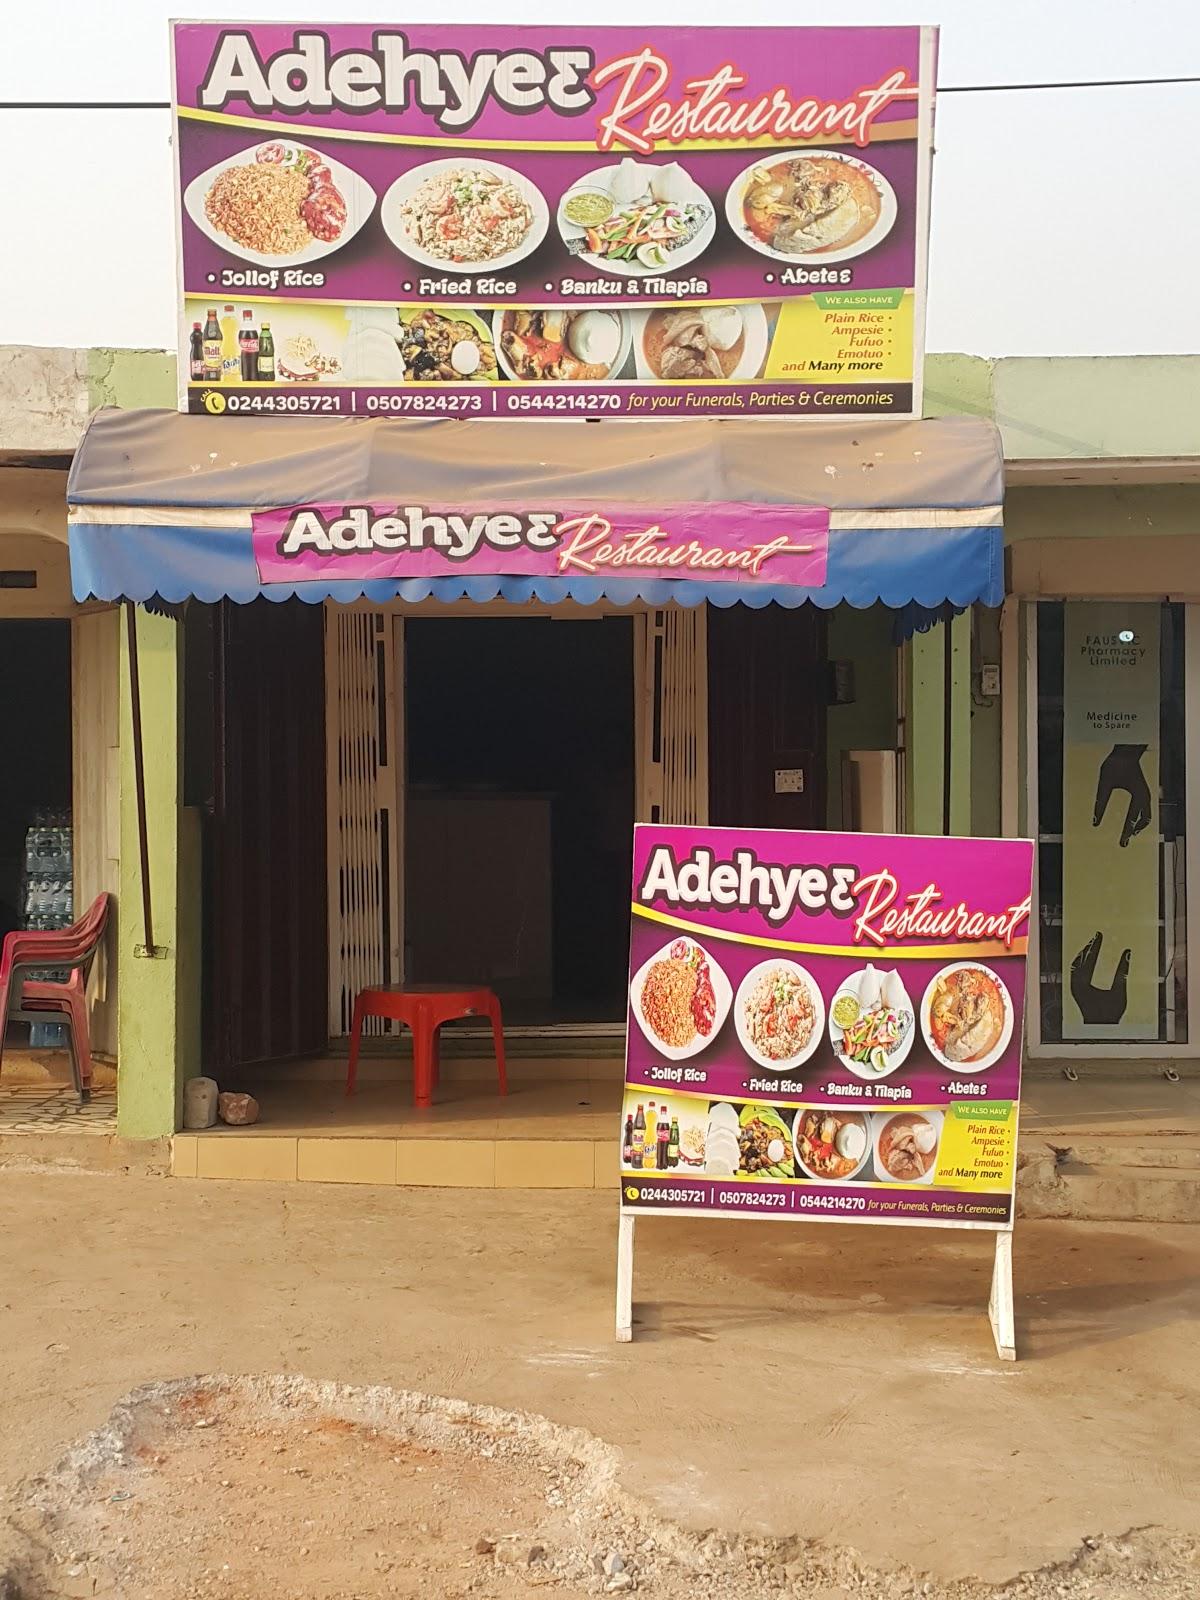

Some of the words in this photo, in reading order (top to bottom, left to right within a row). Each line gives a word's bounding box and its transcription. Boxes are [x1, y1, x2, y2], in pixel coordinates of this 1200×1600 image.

[593, 47, 919, 151] Restaurant
[221, 269, 280, 289] Jollof
[284, 269, 325, 286] Rice
[419, 278, 472, 295] Fried
[476, 278, 518, 295] Rice
[561, 278, 622, 295] Banku
[626, 281, 639, 295] &
[643, 277, 709, 298] Tilapia
[825, 296, 842, 304] WE
[869, 296, 893, 304] HAVE
[824, 312, 855, 323] Plain
[858, 312, 884, 323] Rice
[831, 324, 884, 338] Ampesie
[837, 348, 884, 359] Emotuo
[782, 360, 806, 371] and
[808, 360, 843, 374] Many
[848, 361, 883, 371] more
[227, 395, 341, 411] 0244305721
[366, 395, 482, 411] 0507824273
[507, 394, 622, 411] 0544214270
[627, 393, 649, 411] for
[651, 396, 683, 411] your
[685, 391, 745, 409] Funerals,
[749, 391, 796, 406] Parties
[799, 391, 810, 406] &
[813, 390, 893, 406] Ceremonies
[555, 513, 813, 576] Restaurant
[1080, 646, 1146, 657] Pharmacy
[1090, 656, 1137, 666] Limited
[1086, 711, 1138, 721] Medicine
[1093, 721, 1103, 729] to
[1105, 721, 1131, 730] Spare
[852, 869, 1032, 947] Restaurant
[651, 1066, 683, 1083] Jollof
[684, 1068, 707, 1082] Rice
[749, 1078, 779, 1092] Fried
[780, 1079, 803, 1093] Rice
[826, 1082, 863, 1097] Banku
[865, 1086, 872, 1096] &
[874, 1084, 912, 1101] Tilapia
[957, 1105, 970, 1114] WE
[967, 1124, 987, 1134] Plain
[988, 1125, 1006, 1135] Rice
[971, 1136, 1005, 1148] Ampesie
[974, 1158, 1004, 1168] Emotuo
[938, 1167, 954, 1177] and
[955, 1167, 979, 1181] Many
[980, 1169, 1003, 1179] more
[640, 1187, 706, 1203] 0244305721
[719, 1191, 786, 1207] 0507824273
[799, 1195, 866, 1211] 0544214270
[867, 1199, 879, 1210] for
[880, 1202, 897, 1212] your
[898, 1200, 929, 1213] Funerals,
[931, 1202, 956, 1214] Parties
[964, 1204, 1007, 1216] Ceremonies
